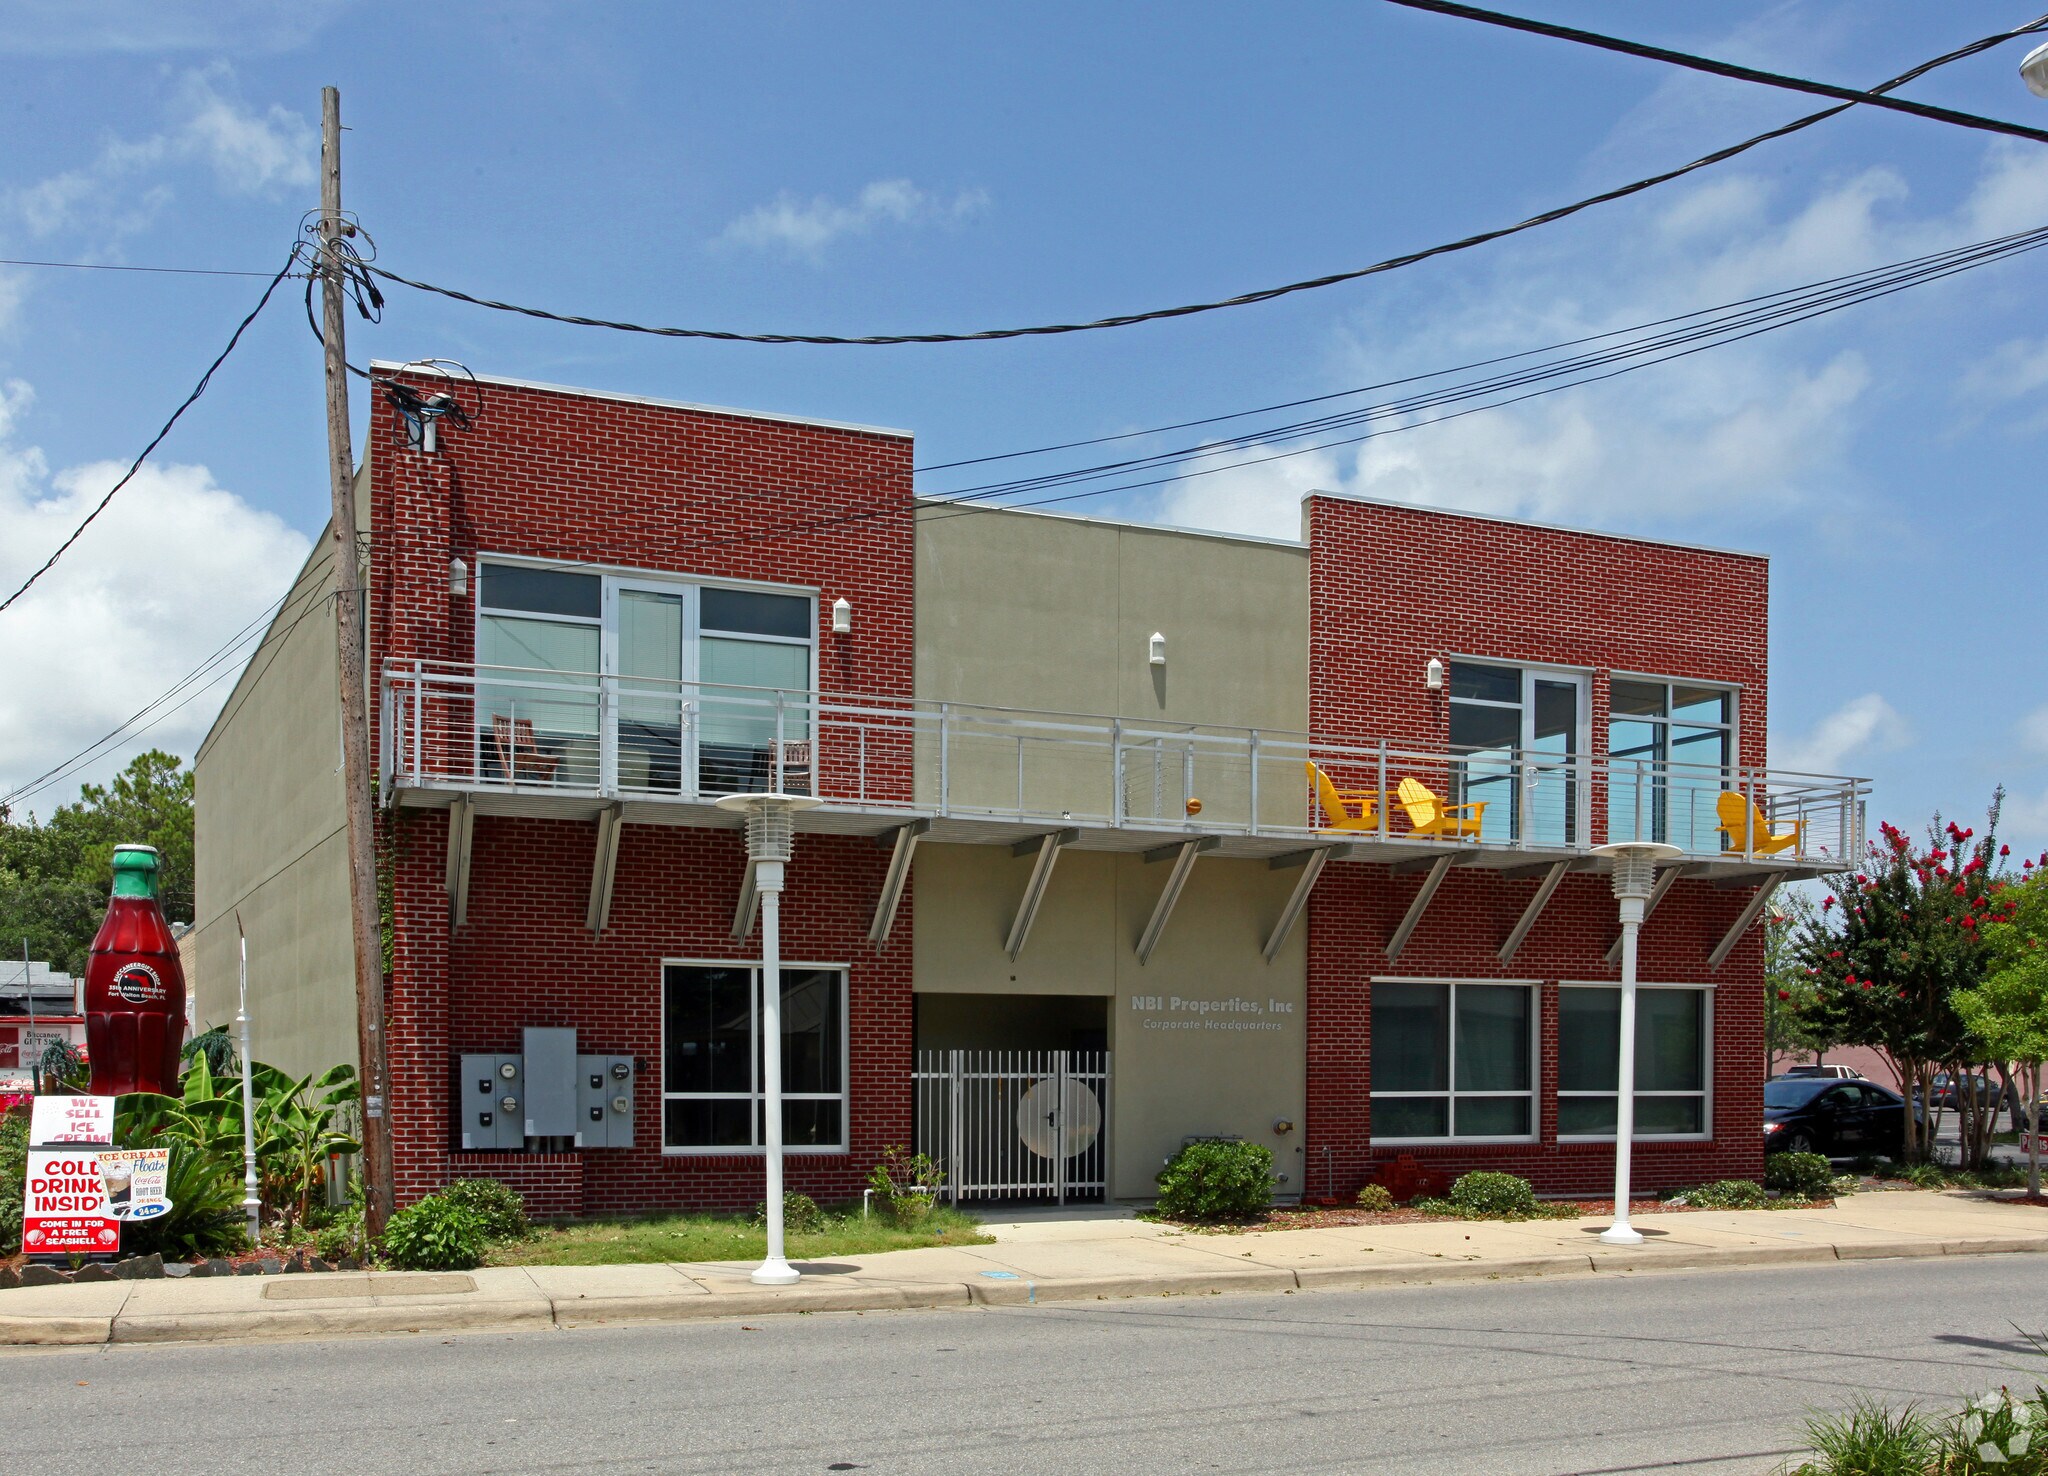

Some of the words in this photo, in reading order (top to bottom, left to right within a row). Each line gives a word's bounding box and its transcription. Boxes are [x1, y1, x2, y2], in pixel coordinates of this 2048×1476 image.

[152, 971, 161, 985] SHOP
[123, 986, 166, 994] ANNIVERSARY
[1131, 996, 1162, 1010] NBI
[1170, 996, 1263, 1015] Properties,
[1269, 998, 1293, 1013] Inc
[1143, 1018, 1200, 1031] Corporate
[1204, 1019, 1282, 1032] Headquarters
[71, 1098, 98, 1107] WE
[65, 1109, 104, 1118] SELL
[71, 1122, 95, 1132] ICE
[54, 1132, 112, 1142] CREAM!
[98, 1152, 119, 1161] ICE
[122, 1150, 167, 1160] CREAM
[133, 1157, 166, 1174] Floats
[31, 1178, 103, 1194] DRINK
[138, 1206, 150, 1216] 24
[39, 1220, 68, 1228] COME
